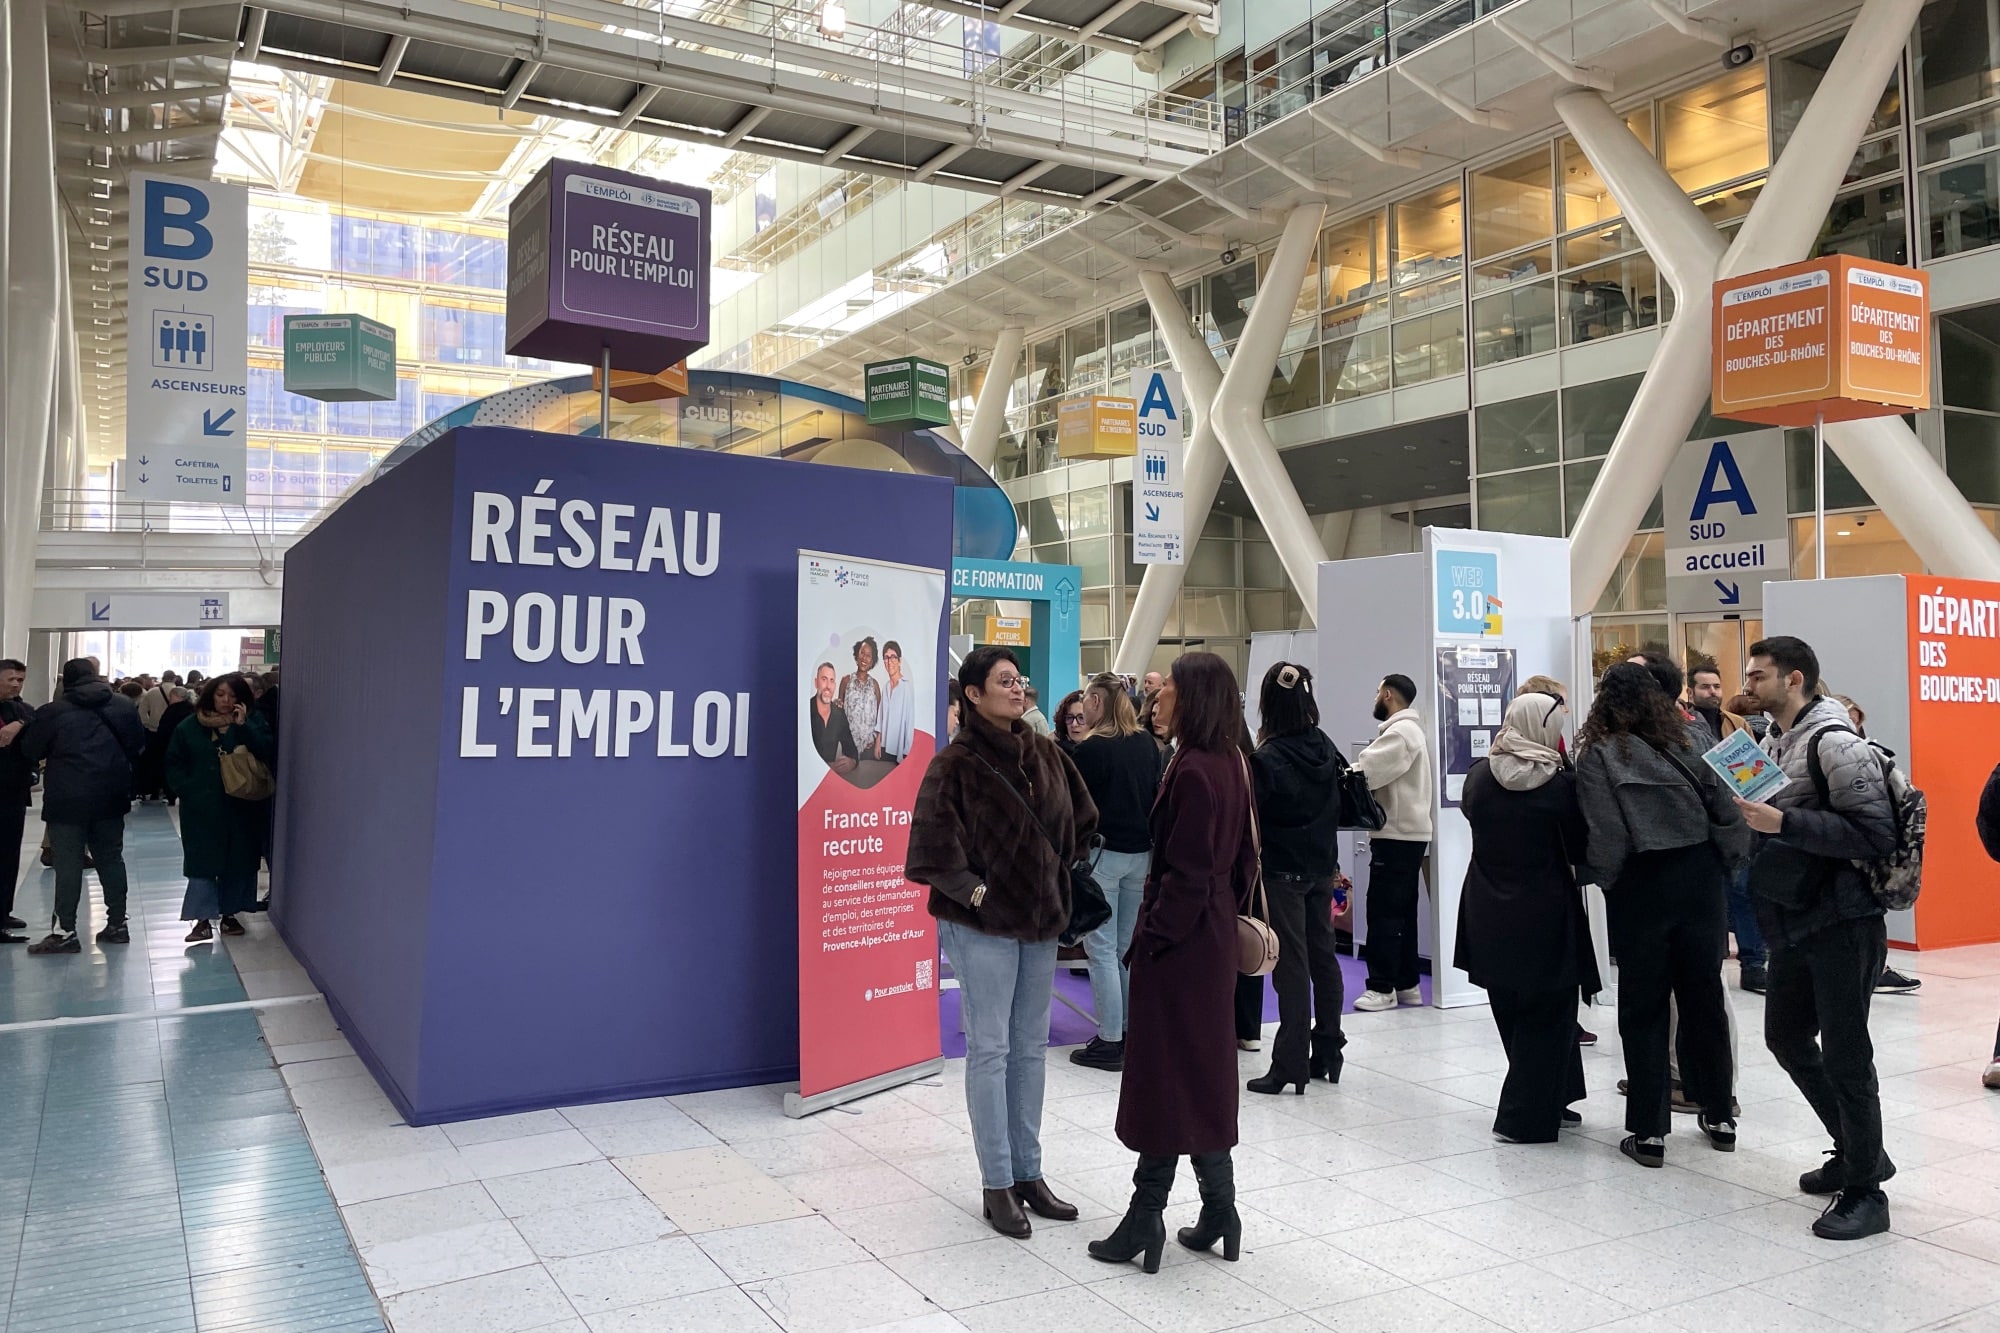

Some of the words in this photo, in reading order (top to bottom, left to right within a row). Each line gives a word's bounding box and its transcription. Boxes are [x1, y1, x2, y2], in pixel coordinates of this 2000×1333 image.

[144, 179, 213, 261] B
[592, 222, 674, 263] RÉSEAU
[143, 266, 208, 292] SUD
[570, 249, 616, 276] POUR
[621, 257, 694, 289] L'EMPLOI
[1727, 306, 1825, 342] DÉPARTEMENT
[1851, 302, 1920, 333] DÉPARTEMENT
[295, 341, 346, 353] EMPLOYEURS
[1765, 334, 1784, 350] DES
[1879, 330, 1893, 345] DES
[304, 352, 337, 363] PUBLICS
[362, 344, 391, 362] EMPLOYEURS
[1726, 342, 1825, 373] BOUCHES-DU-RHÔNE
[1850, 341, 1921, 366] BOUCHES-DU-RHÔNE
[151, 378, 247, 396] ASCENSEURS
[870, 380, 910, 394] PARTENAIRES
[918, 381, 946, 396] PARTENAIRES
[1139, 372, 1177, 420] A
[685, 405, 729, 422] CLUB
[1138, 422, 1167, 437] SUD
[1690, 441, 1758, 521] A
[1143, 489, 1184, 499] ASCENSEURS
[470, 478, 721, 577] RÉSEAU
[1690, 523, 1726, 541] SUD
[1686, 543, 1765, 572] accueil
[850, 571, 870, 580] France
[850, 578, 869, 587] Travail
[971, 570, 1044, 592] FORMATION
[1451, 566, 1484, 588] WEB
[1452, 589, 1484, 620] 3.0
[1918, 586, 2000, 638] DÉPART
[465, 589, 646, 665] POUR
[1919, 640, 1947, 668] DES
[1467, 671, 1490, 683] RÉSEAU
[1457, 684, 1474, 694] POUR
[1474, 684, 1501, 694] L'EMPLOI
[459, 686, 751, 758] L'EMPLOI
[824, 809, 878, 830] France
[823, 835, 883, 857] recrute
[823, 868, 861, 881] Rejoignez
[862, 867, 875, 876] nos
[876, 864, 905, 876] équipes
[822, 884, 833, 894] de
[834, 880, 875, 893] conseillers
[875, 877, 905, 890] engagés
[822, 900, 832, 909] au
[833, 896, 861, 907] service
[862, 893, 876, 904] des
[876, 889, 921, 903] demandeurs
[822, 910, 859, 923] d'emploi,
[860, 907, 874, 918] des
[875, 903, 914, 916] entreprises
[822, 928, 831, 938] et
[832, 926, 847, 936] des
[848, 922, 884, 935] territoires
[885, 919, 895, 929] de
[823, 931, 900, 953] Provence-Alpes-Côte
[902, 929, 925, 940] d'Azur
[874, 987, 888, 998] Pour
[888, 982, 914, 996] postuler
